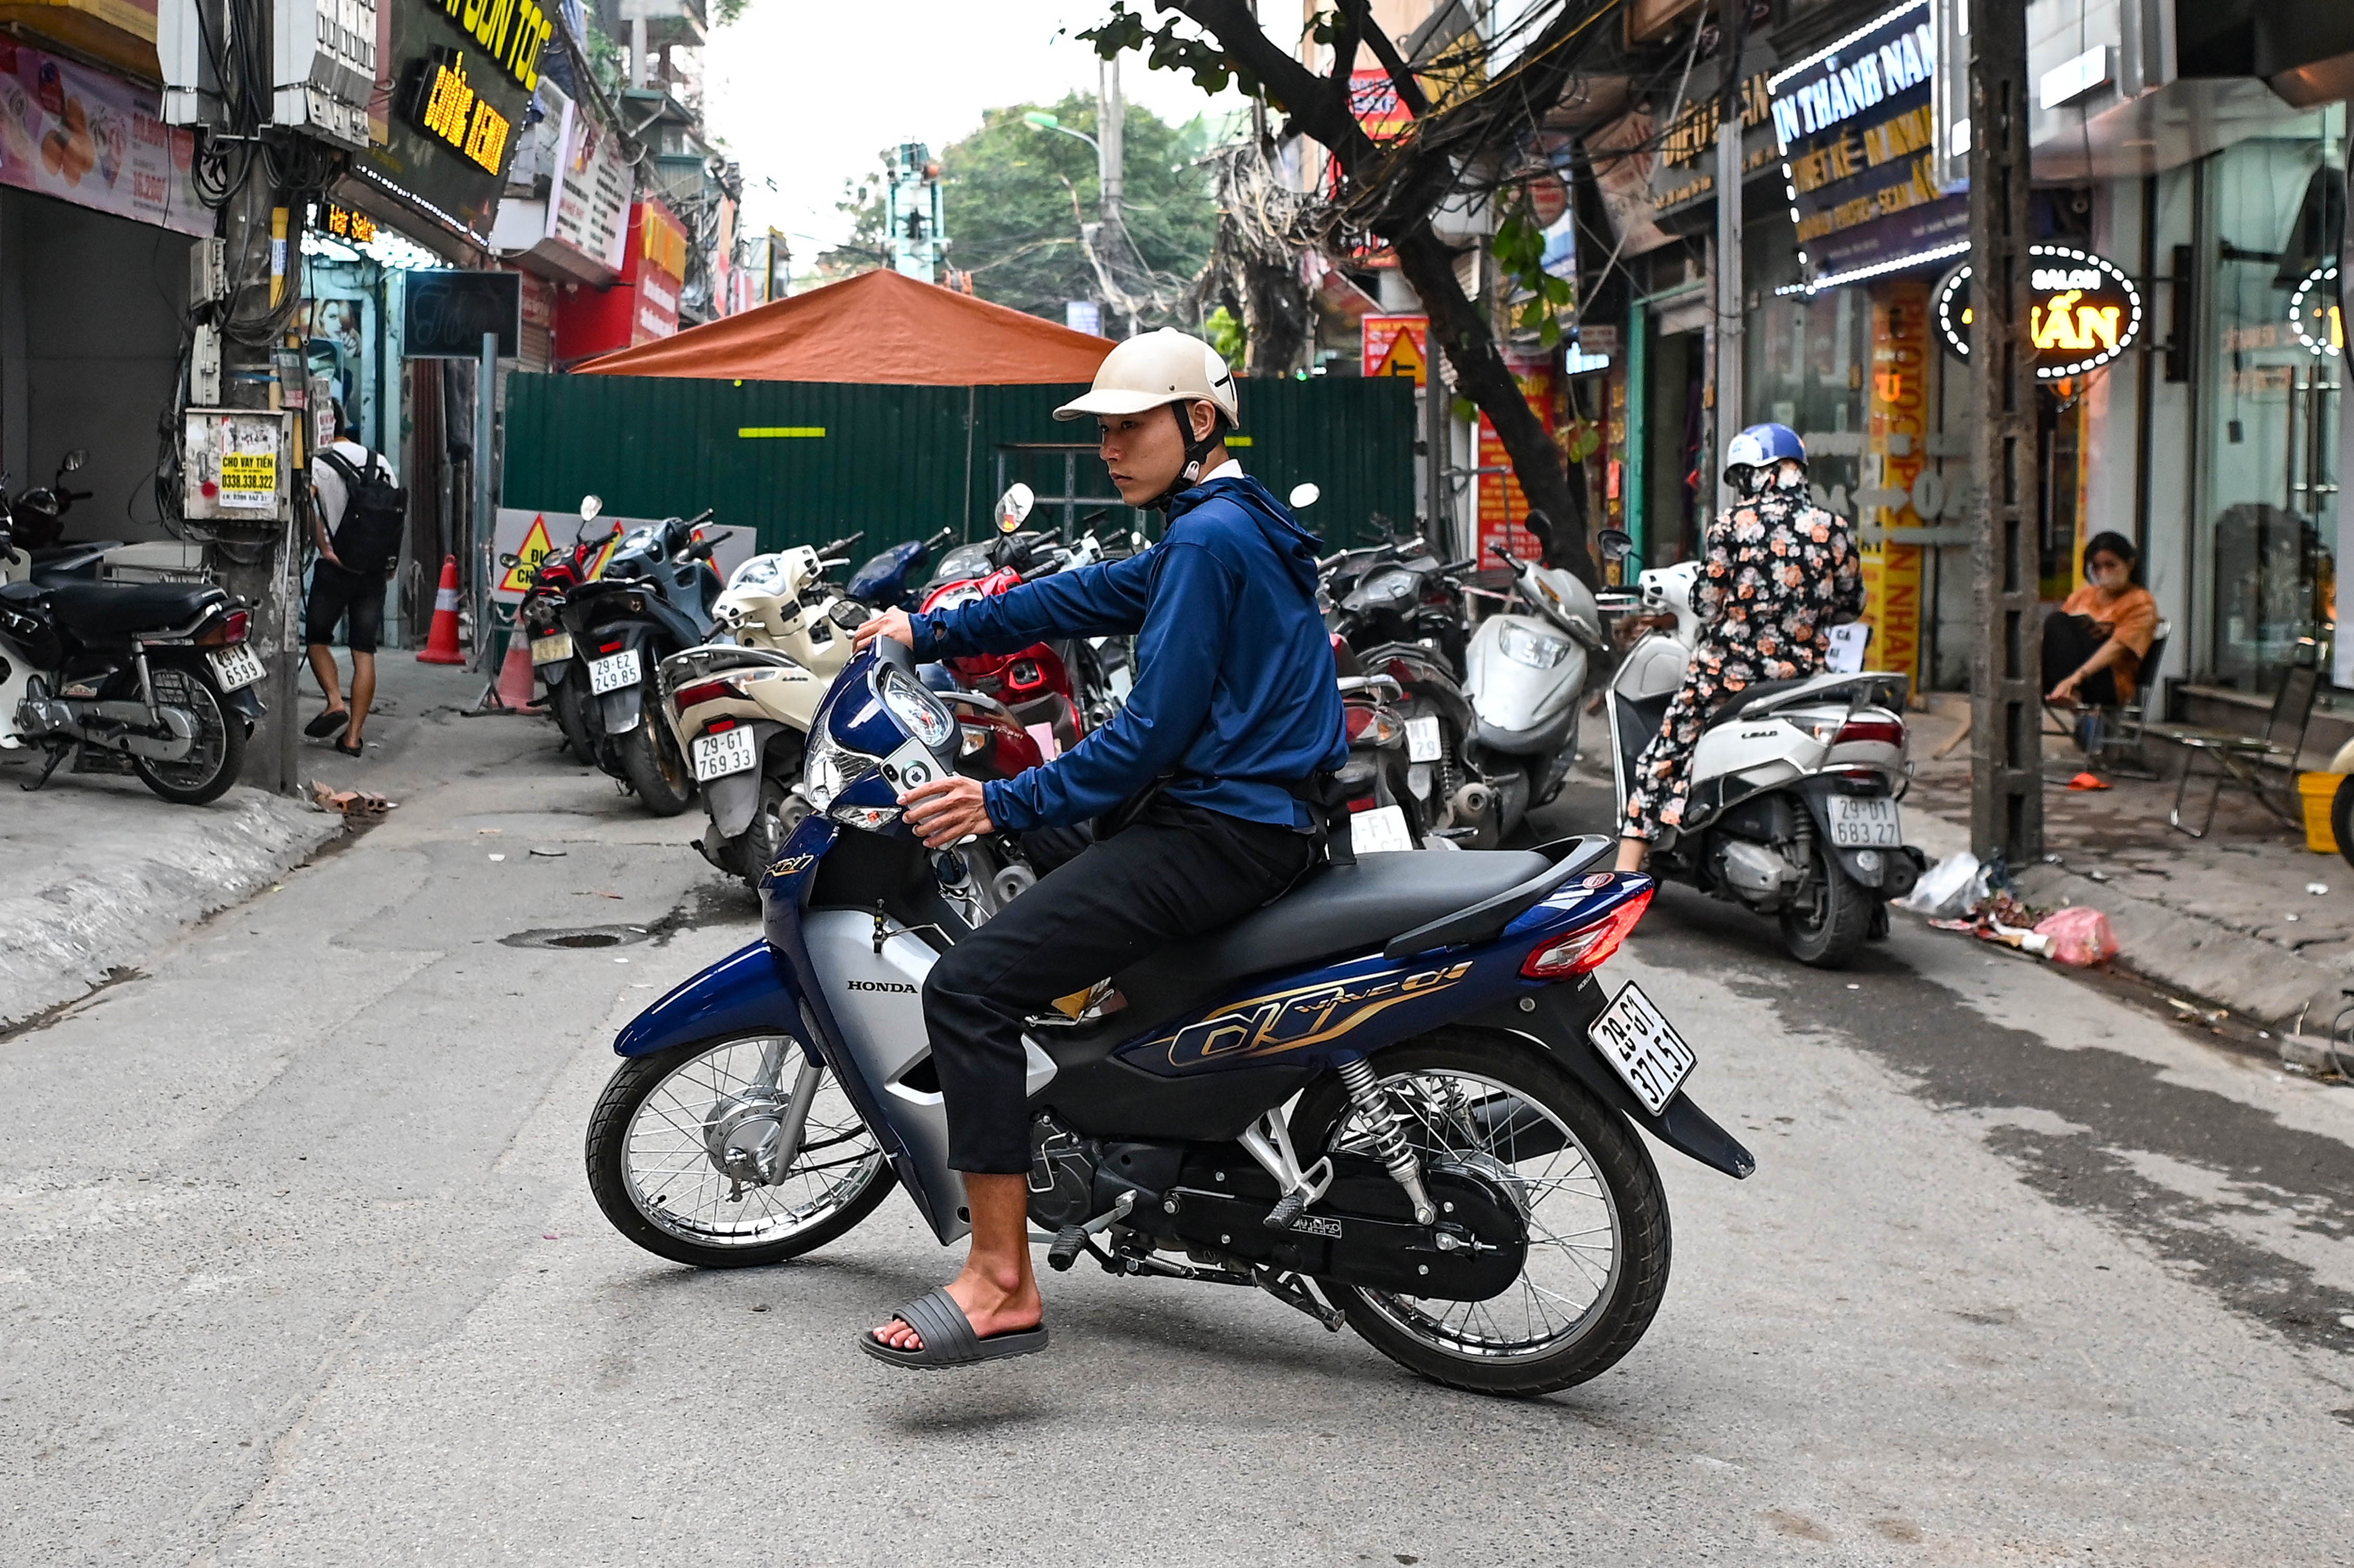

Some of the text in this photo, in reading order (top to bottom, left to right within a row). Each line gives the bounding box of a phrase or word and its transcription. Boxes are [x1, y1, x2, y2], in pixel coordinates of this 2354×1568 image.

[1771, 94, 1801, 143] IN
[1797, 56, 1885, 134] THÀNH
[2032, 268, 2101, 291] SALON
[223, 456, 239, 468] CHO
[240, 457, 254, 468] VAY
[221, 474, 273, 489] 0338.338.322
[225, 661, 258, 685] 6599
[597, 654, 631, 676] 29-E2
[595, 668, 637, 691] 249.85
[702, 730, 742, 757] 29-G1
[1741, 730, 1778, 739] LEAD
[699, 749, 751, 778] 769.33
[1837, 822, 1895, 844] 683.27
[847, 981, 919, 994] HONDA
[1630, 1027, 1690, 1104] 371.51
